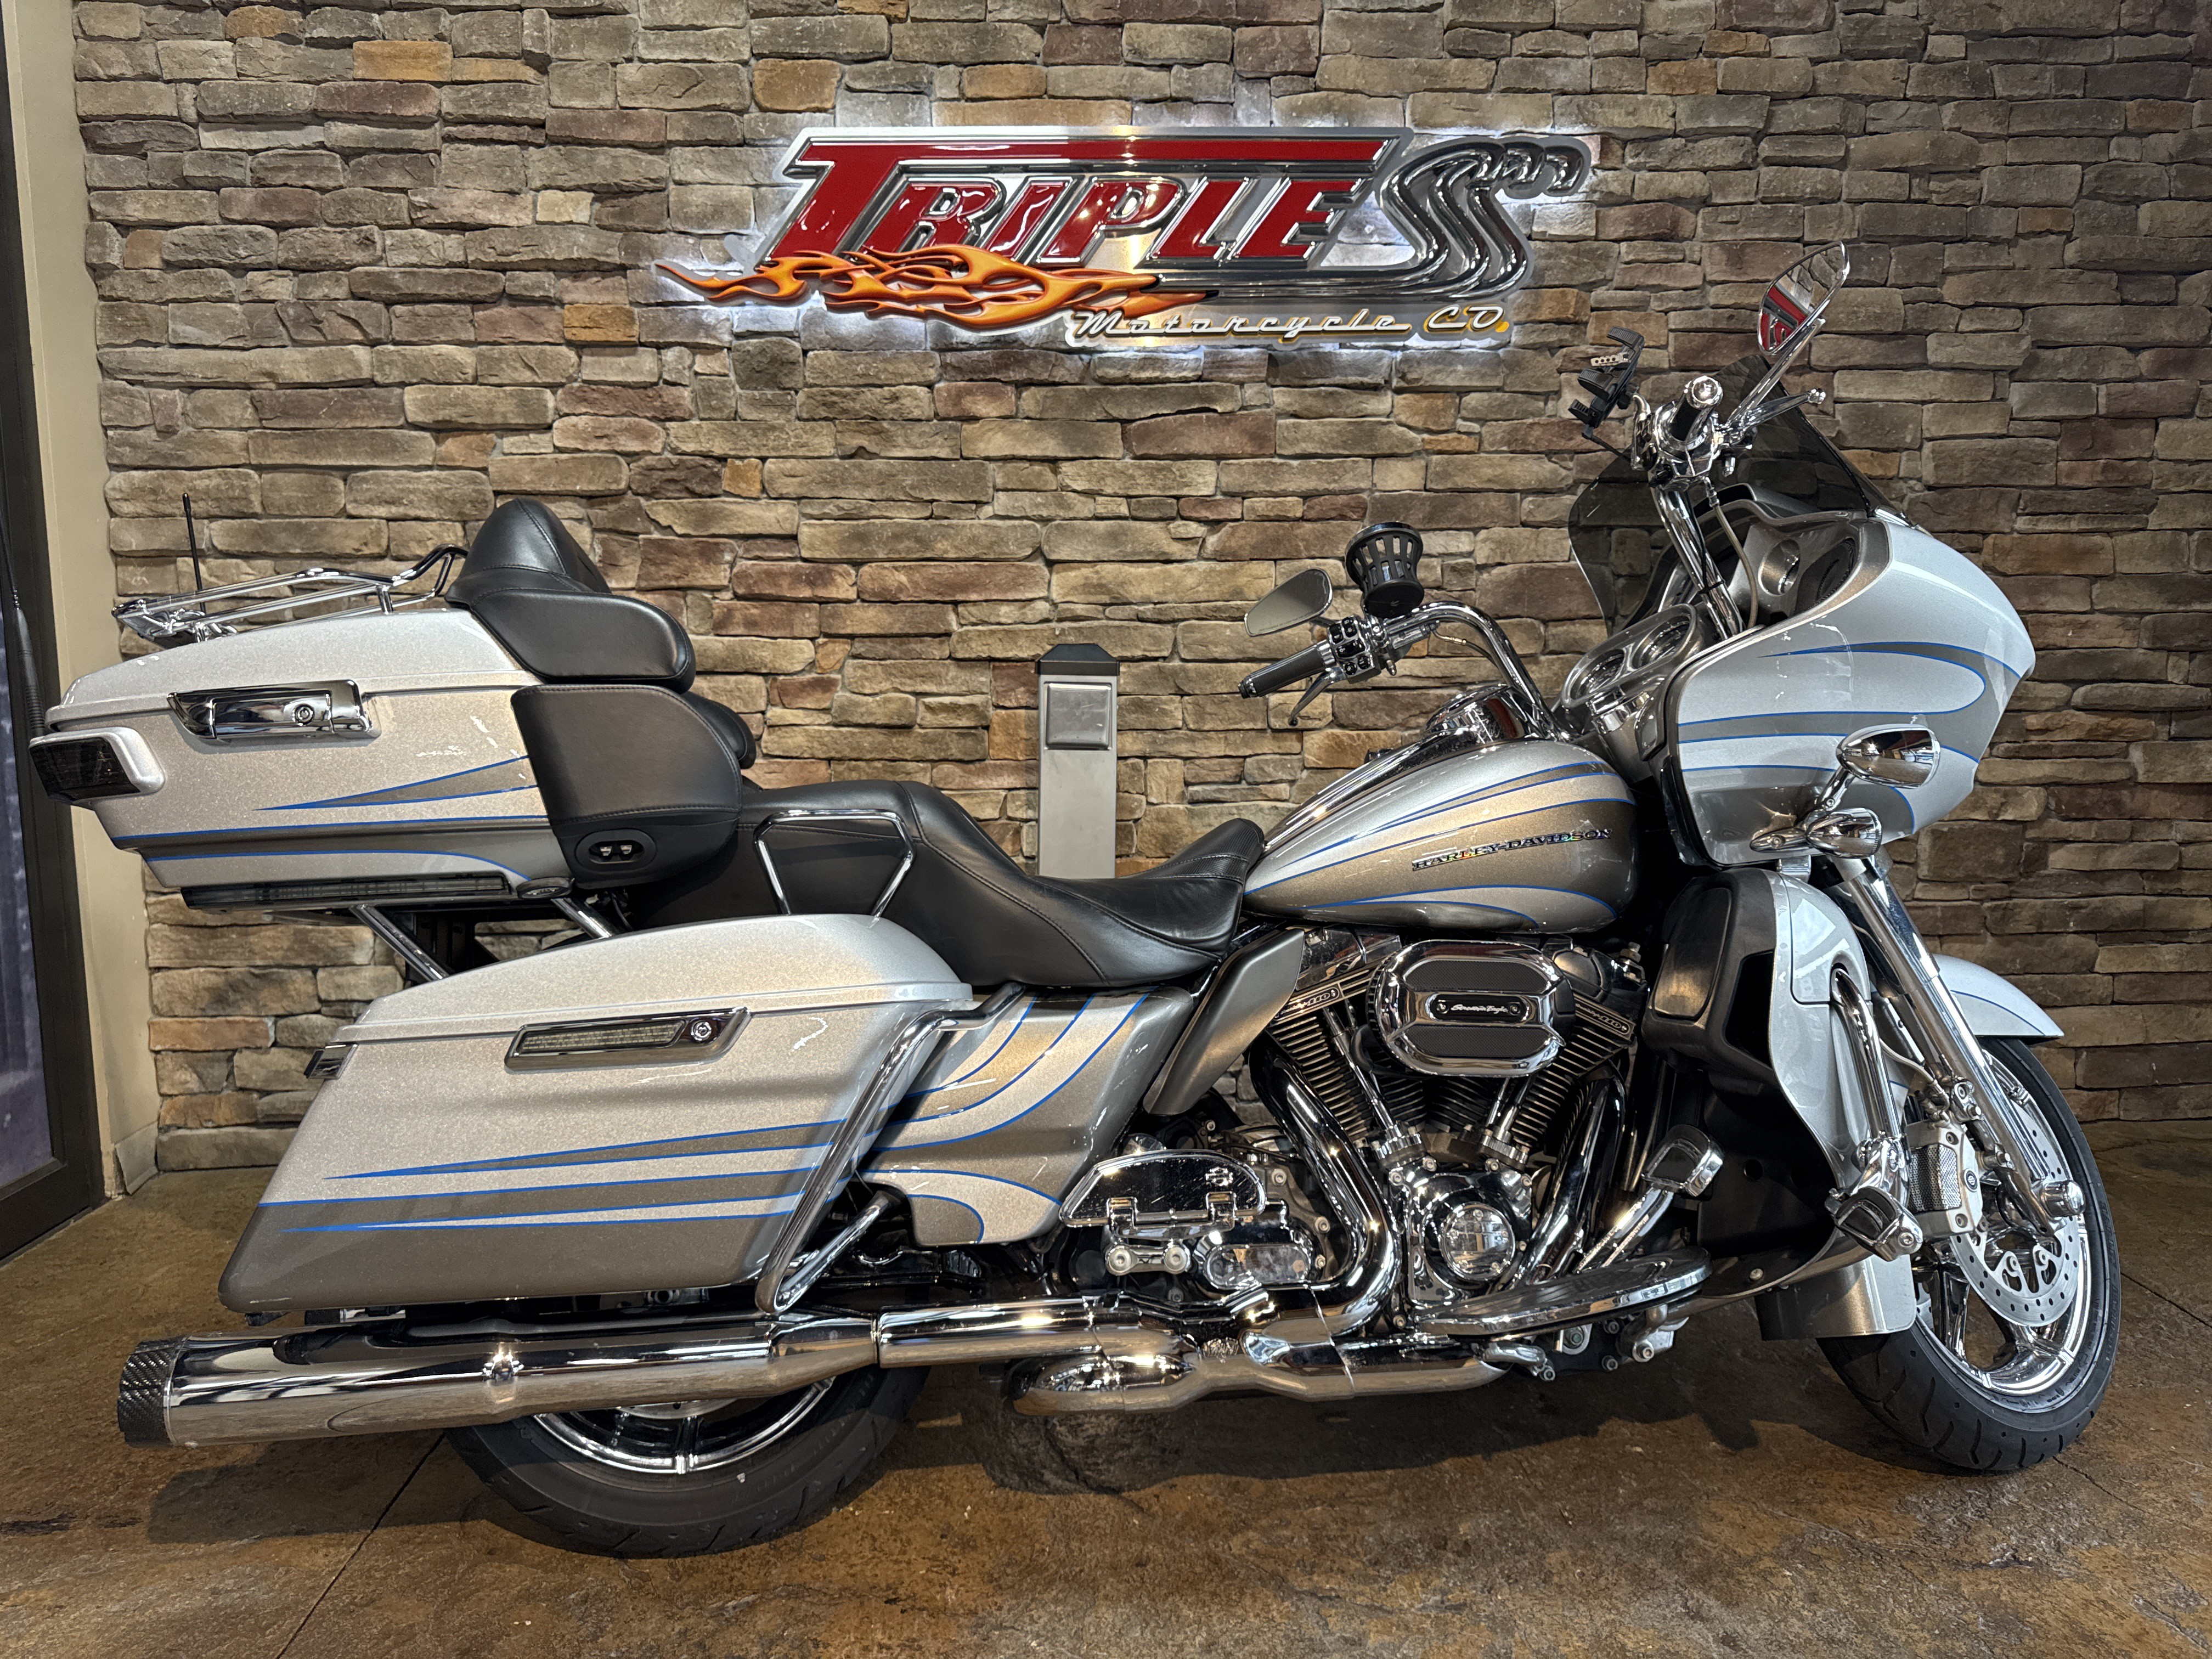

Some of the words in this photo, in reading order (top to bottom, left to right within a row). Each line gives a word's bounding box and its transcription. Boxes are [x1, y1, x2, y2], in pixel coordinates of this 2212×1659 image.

[761, 136, 1402, 268] TRIPLE
[1073, 309, 1412, 342] Motorcycle
[1412, 829, 1613, 871] HARLEY-DAVIDSON
